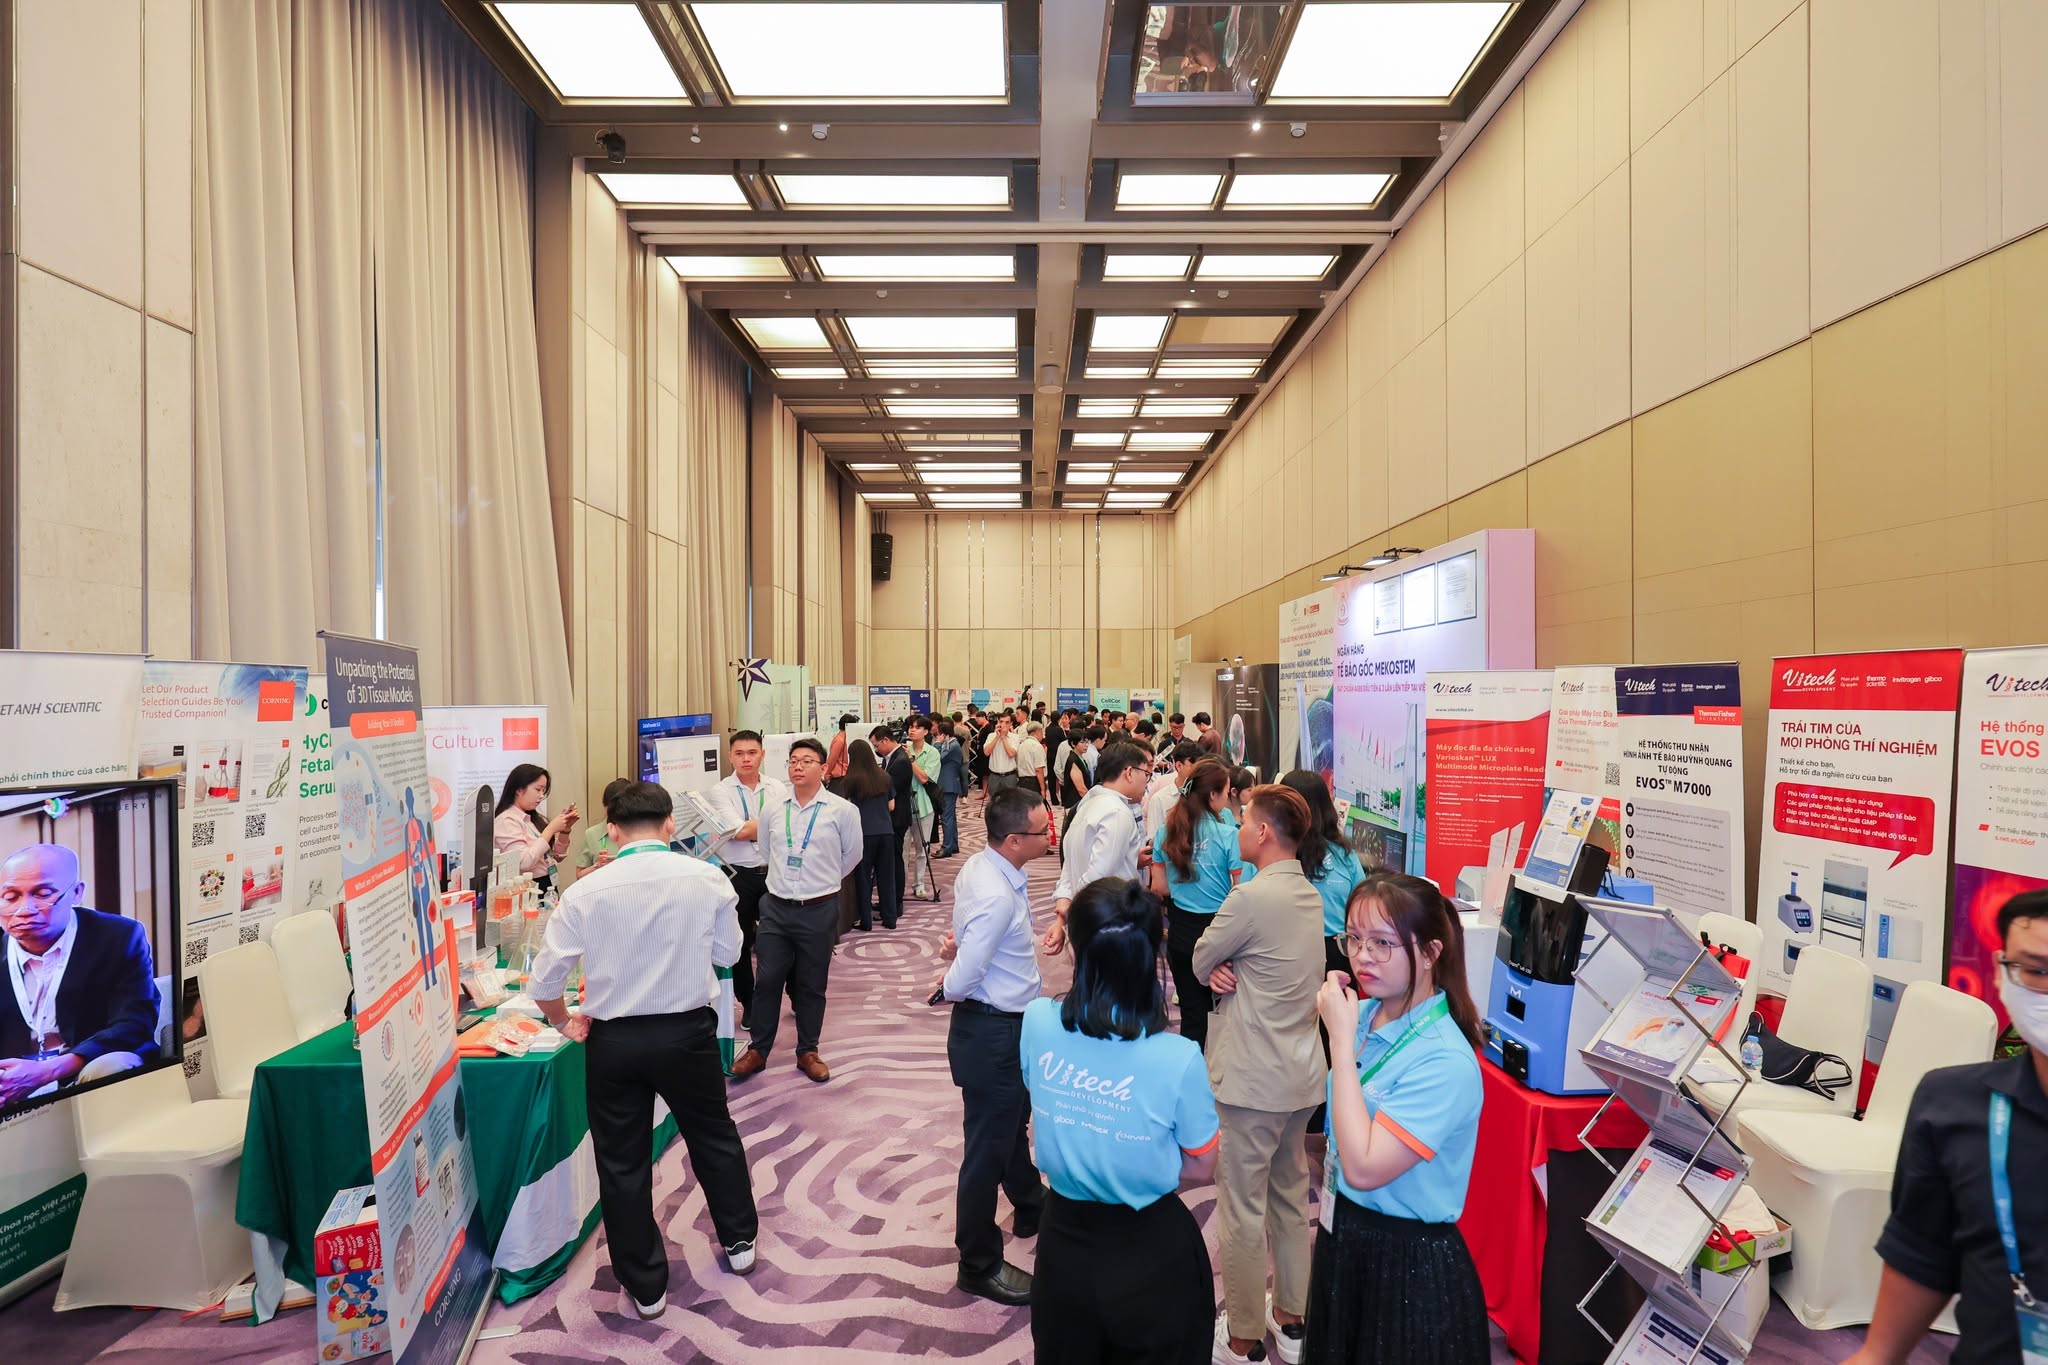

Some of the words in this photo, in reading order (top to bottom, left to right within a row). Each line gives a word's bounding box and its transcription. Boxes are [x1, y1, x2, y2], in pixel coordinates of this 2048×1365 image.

[335, 657, 377, 684] Unpacking
[377, 662, 388, 679] the
[388, 663, 415, 681] Potential
[1374, 659, 1416, 676] MEKOSTEM
[1624, 678, 1656, 692] Vitech
[1782, 669, 1837, 687] Vitech
[1924, 676, 1942, 684] gibco
[1986, 673, 2048, 692] Vitech
[142, 685, 155, 694] Let
[156, 685, 173, 694] Our
[174, 685, 209, 695] Product
[347, 687, 356, 704] of
[358, 686, 367, 704] 3D
[367, 686, 389, 704] Tissue
[389, 686, 414, 703] Models
[1433, 682, 1473, 694] Vitech
[14, 703, 41, 715] ANH
[44, 702, 102, 714] SCIENTIFIC
[141, 697, 180, 706] Selection
[182, 697, 212, 706] Guides
[213, 697, 224, 706] Be
[141, 709, 173, 719] Trusted
[174, 709, 227, 720] Companion!
[1782, 720, 1807, 733] TRÁI
[1810, 723, 1833, 734] TIM
[1835, 721, 1862, 735] CỦA
[1980, 720, 2000, 734] Hệ
[2004, 720, 2045, 736] thống
[432, 735, 495, 749] Culture
[1638, 738, 1646, 749] HỆ
[1647, 738, 1672, 750] THỐNG
[1672, 742, 1687, 751] THU
[1689, 741, 1709, 755] NHẬN
[1780, 737, 1802, 750] MỌI
[1805, 736, 1850, 751] PHÒNG
[1853, 737, 1875, 752] THÍ
[1879, 740, 1938, 757] NGHIỆM
[1980, 738, 2040, 758] EVOS
[1653, 750, 1663, 761] TẾ
[1663, 752, 1676, 762] BÀO
[1677, 753, 1704, 765] HUỲNH
[1704, 757, 1733, 768] QUANG
[1780, 757, 1795, 766] Thiết
[1796, 757, 1804, 766] kế
[1805, 759, 1819, 767] cho
[1820, 760, 1835, 769] bạn,
[21, 770, 50, 782] chính
[52, 768, 75, 779] thức
[77, 766, 93, 776] của
[95, 764, 110, 774] các
[1435, 762, 1478, 771] Multimode
[1479, 764, 1522, 773] Microplate
[1668, 765, 1689, 776] ĐỘNG
[1779, 765, 1788, 774] Hỗ
[1789, 767, 1800, 775] trợ
[1801, 767, 1810, 776] tối
[1811, 768, 1821, 777] đa
[1822, 770, 1845, 781] nghiên
[1845, 771, 1860, 780] cứu
[1862, 773, 1876, 782] của
[1878, 774, 1893, 784] bạn
[300, 782, 336, 798] Seru
[1673, 781, 1712, 797] M7000
[299, 827, 311, 836] cell
[312, 823, 333, 833] culture
[1861, 818, 1877, 826] GMP
[299, 835, 331, 848] consistent
[1038, 1051, 1134, 1101] Vitech
[1071, 1091, 1131, 1112] DEVELOPMENT
[1053, 1115, 1075, 1125] gibco
[59, 1189, 77, 1203] Anh
[434, 1268, 461, 1327] CORNING
